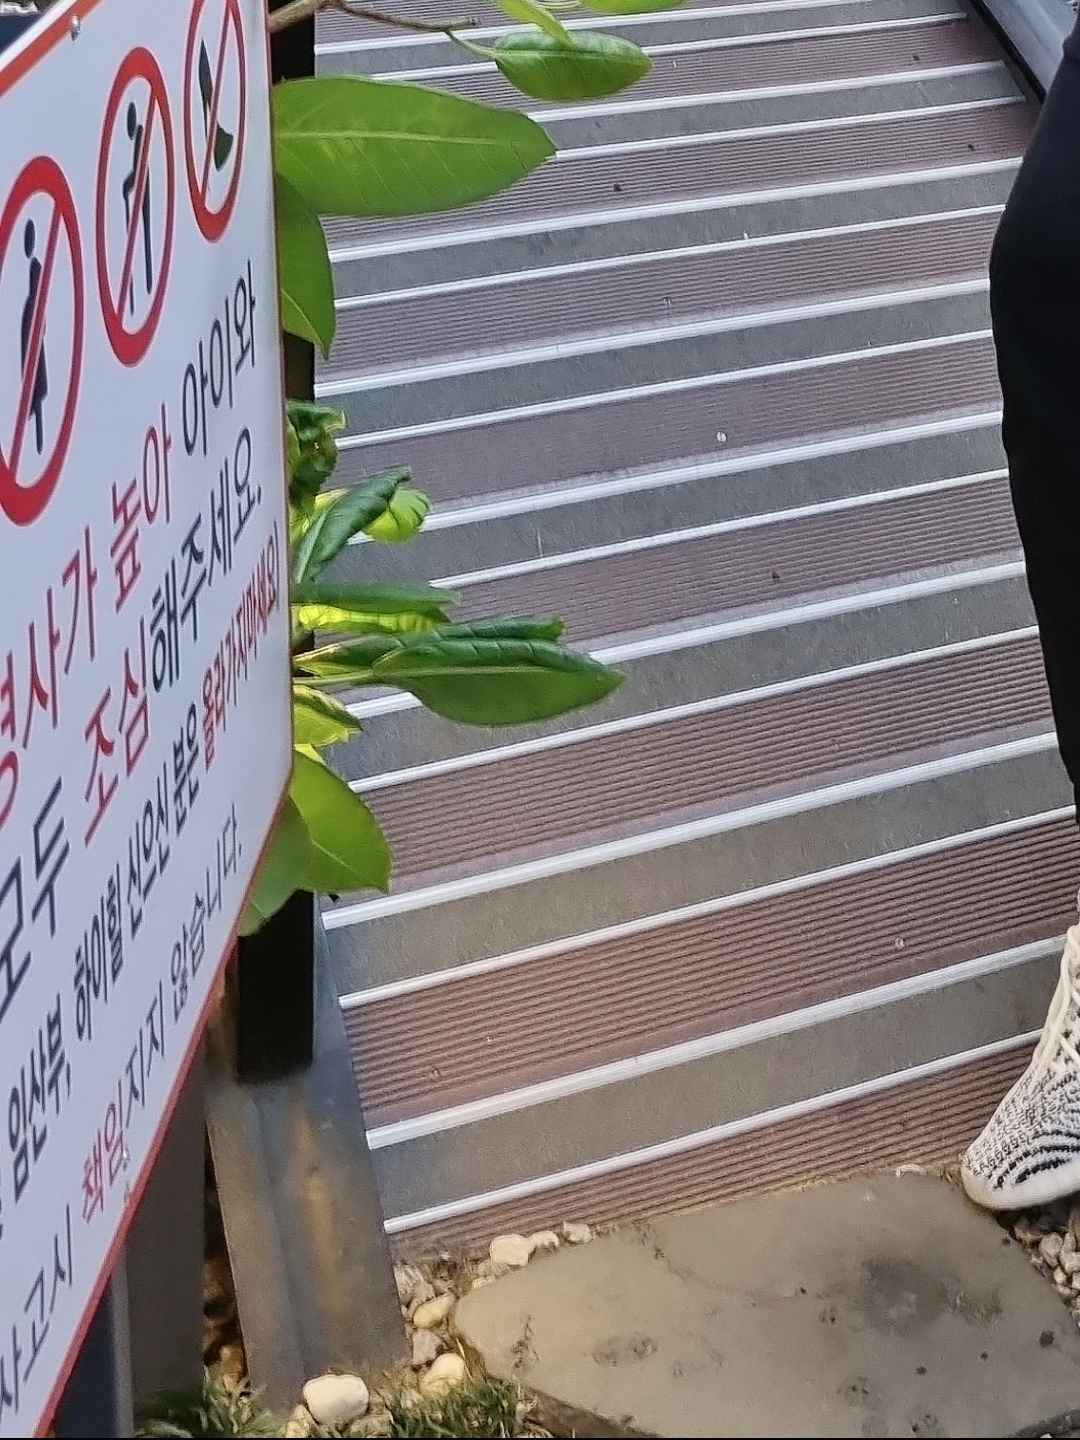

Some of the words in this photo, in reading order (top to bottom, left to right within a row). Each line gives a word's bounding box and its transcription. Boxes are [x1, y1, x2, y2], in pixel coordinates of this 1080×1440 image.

[84, 426, 261, 847] 조심해주세요.
[111, 402, 172, 613] 높아
[182, 259, 256, 456] 아이와
[8, 992, 71, 1203] 임산부,
[74, 862, 123, 1040] 하이힐
[127, 761, 170, 940] 신으신
